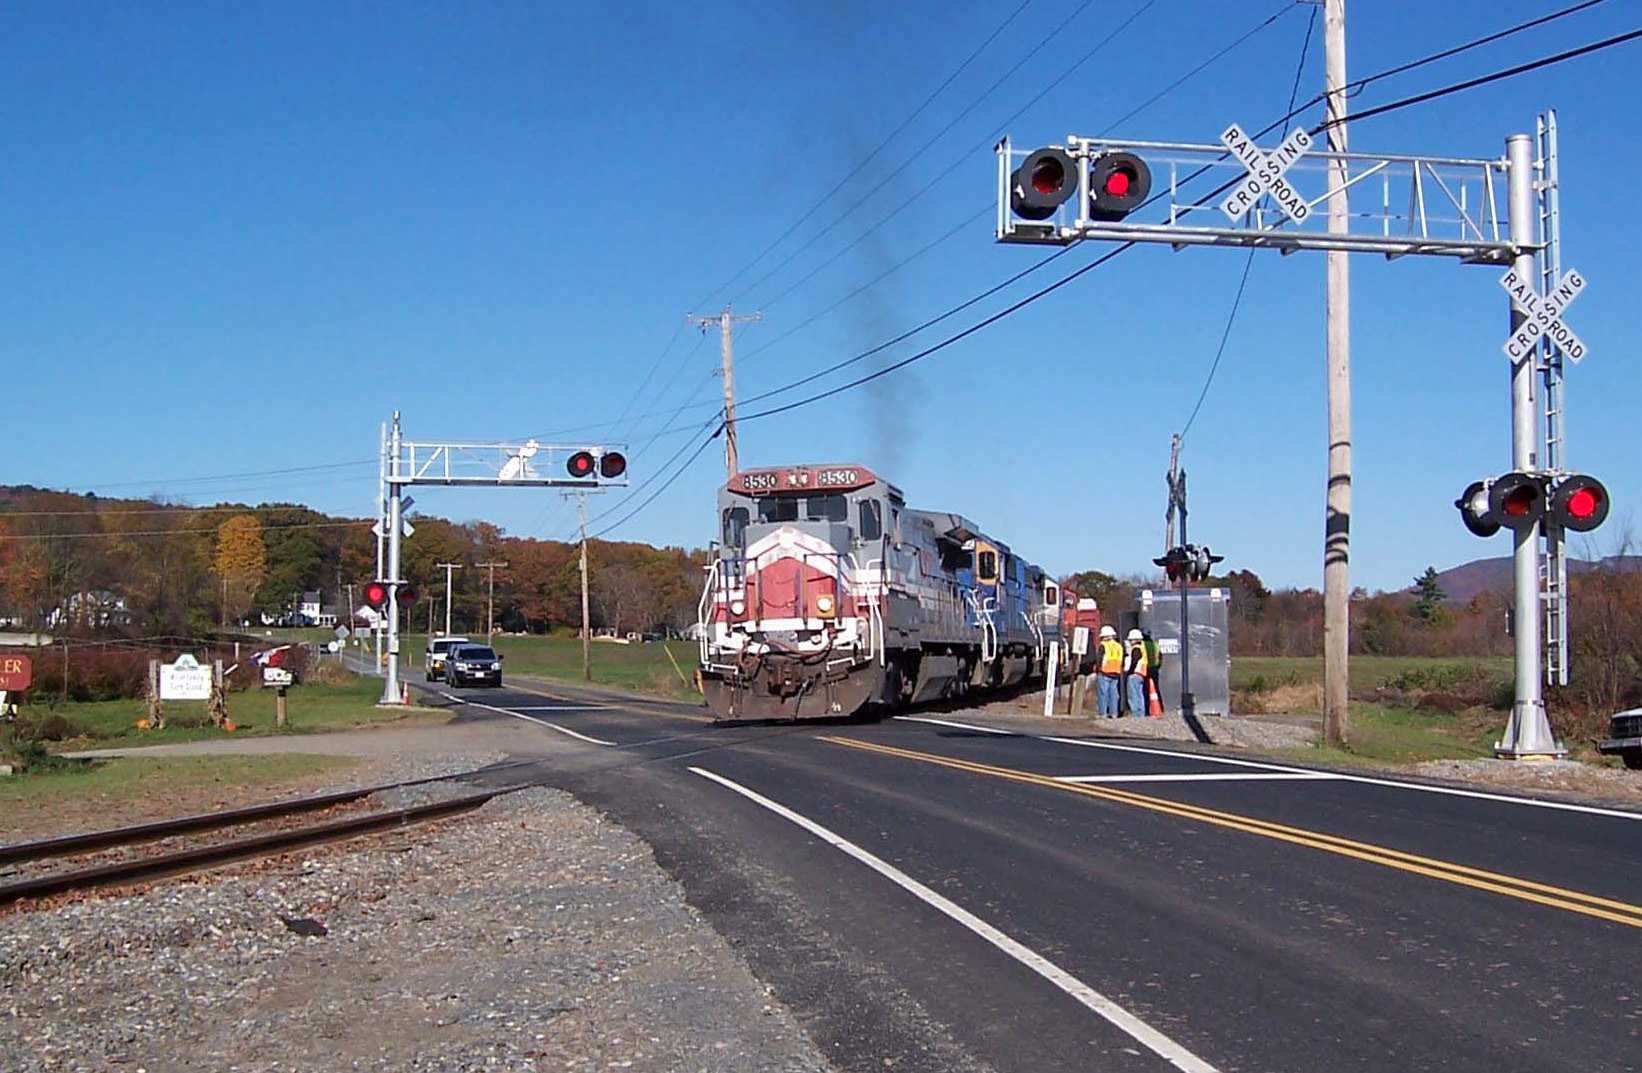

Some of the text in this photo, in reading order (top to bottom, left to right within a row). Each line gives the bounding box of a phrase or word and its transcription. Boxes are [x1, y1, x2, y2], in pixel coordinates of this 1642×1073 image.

[1227, 132, 1308, 215] CROSSING
[1508, 274, 1582, 357] CROSSING
[743, 473, 777, 489] 8530
[818, 470, 858, 484] 8530
[0, 659, 22, 673] ER
